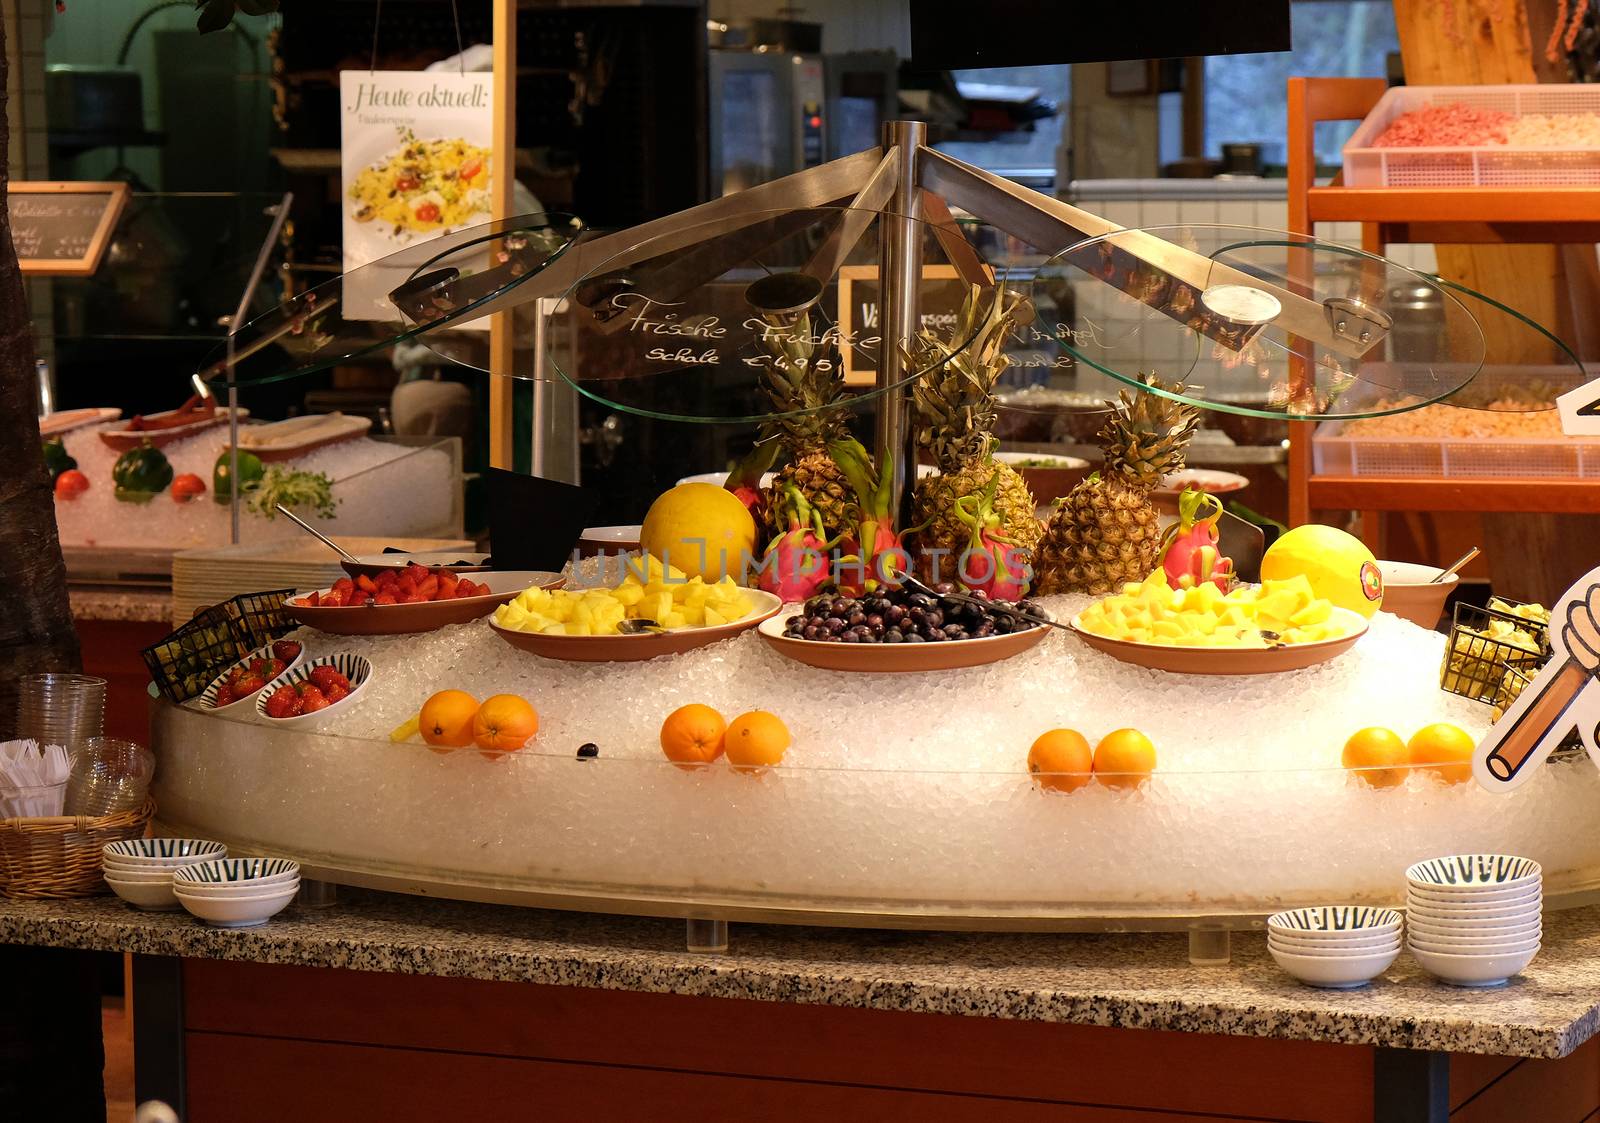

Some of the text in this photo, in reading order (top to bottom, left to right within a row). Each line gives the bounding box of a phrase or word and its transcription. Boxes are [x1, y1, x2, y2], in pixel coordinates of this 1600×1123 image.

[347, 83, 489, 113] Heute aktuell:
[612, 292, 727, 339] Frische
[645, 348, 721, 365] Schale
